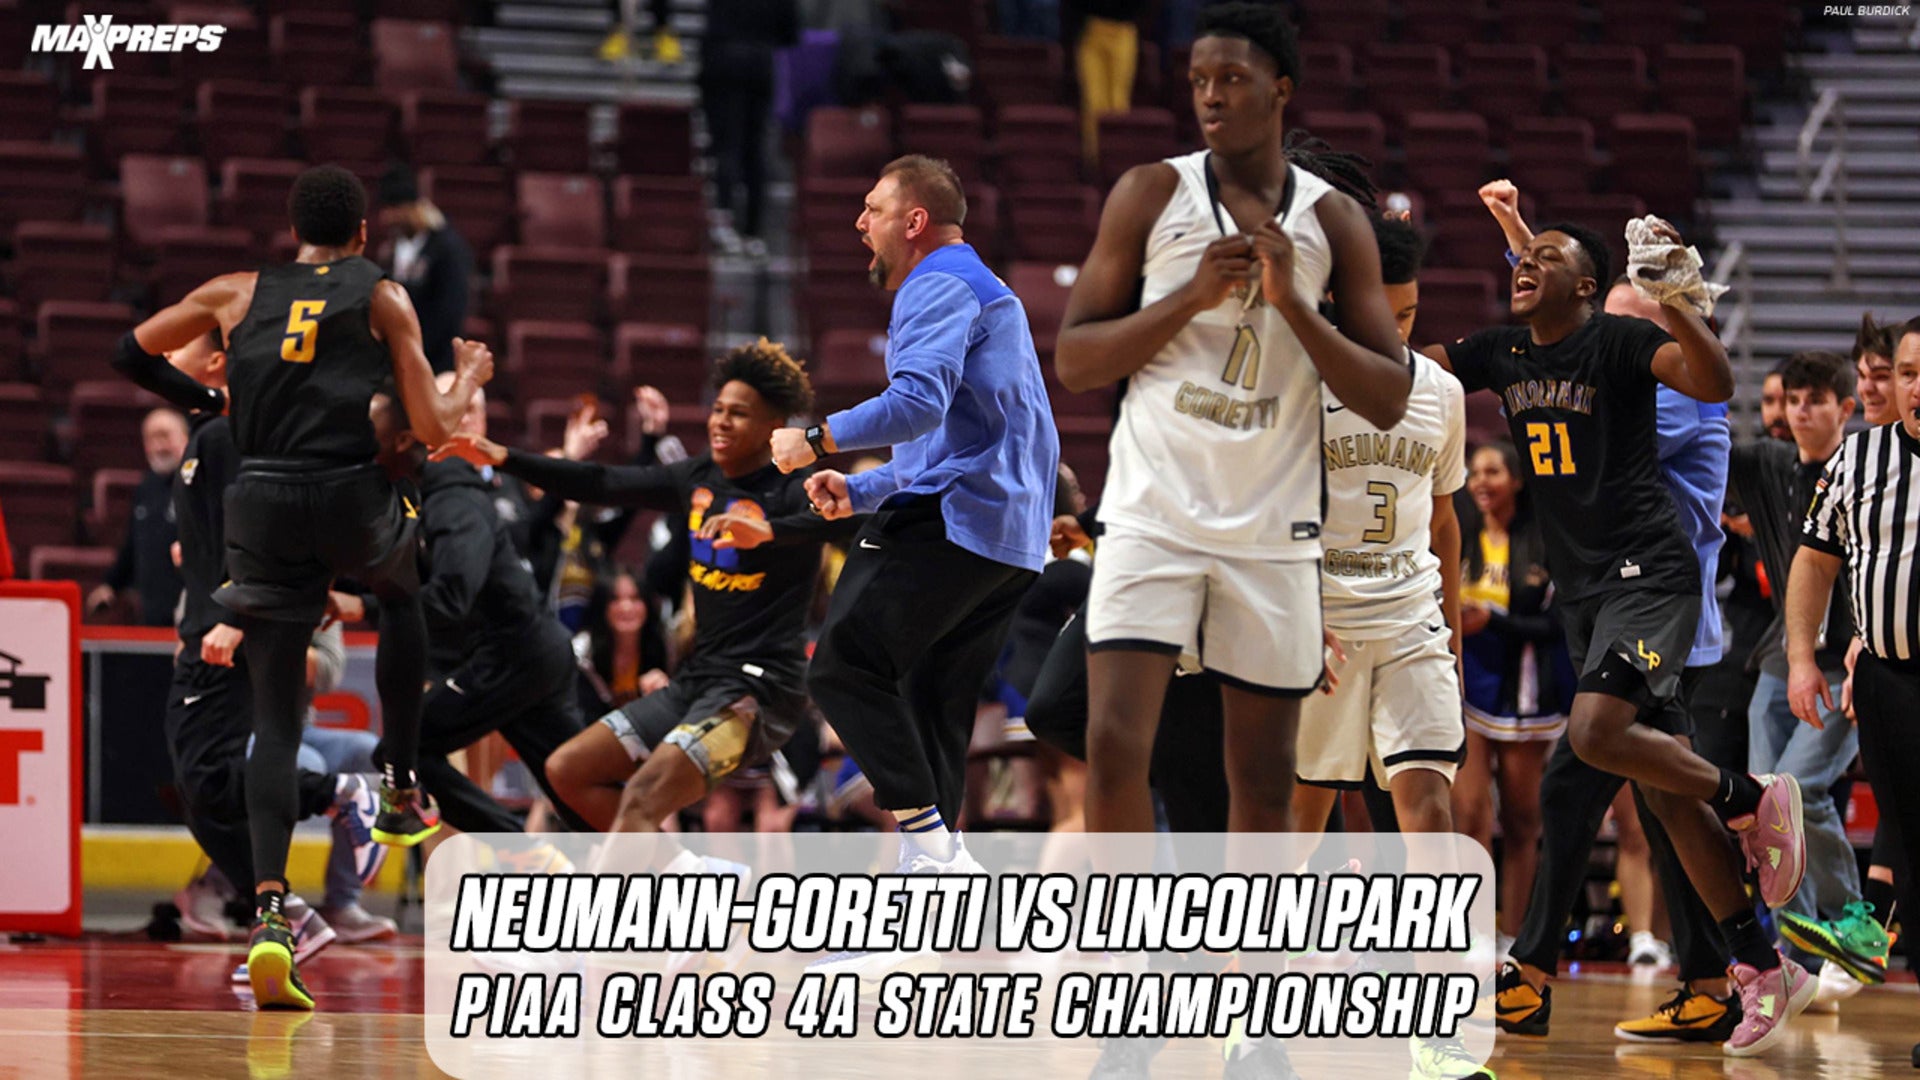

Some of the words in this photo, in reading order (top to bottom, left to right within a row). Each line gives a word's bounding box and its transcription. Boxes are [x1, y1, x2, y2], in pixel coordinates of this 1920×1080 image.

[281, 299, 327, 363] 5
[1174, 381, 1281, 431] GORETTI
[1322, 432, 1438, 478] NEUMANN
[1525, 421, 1577, 476] 21
[1362, 481, 1398, 544] 3
